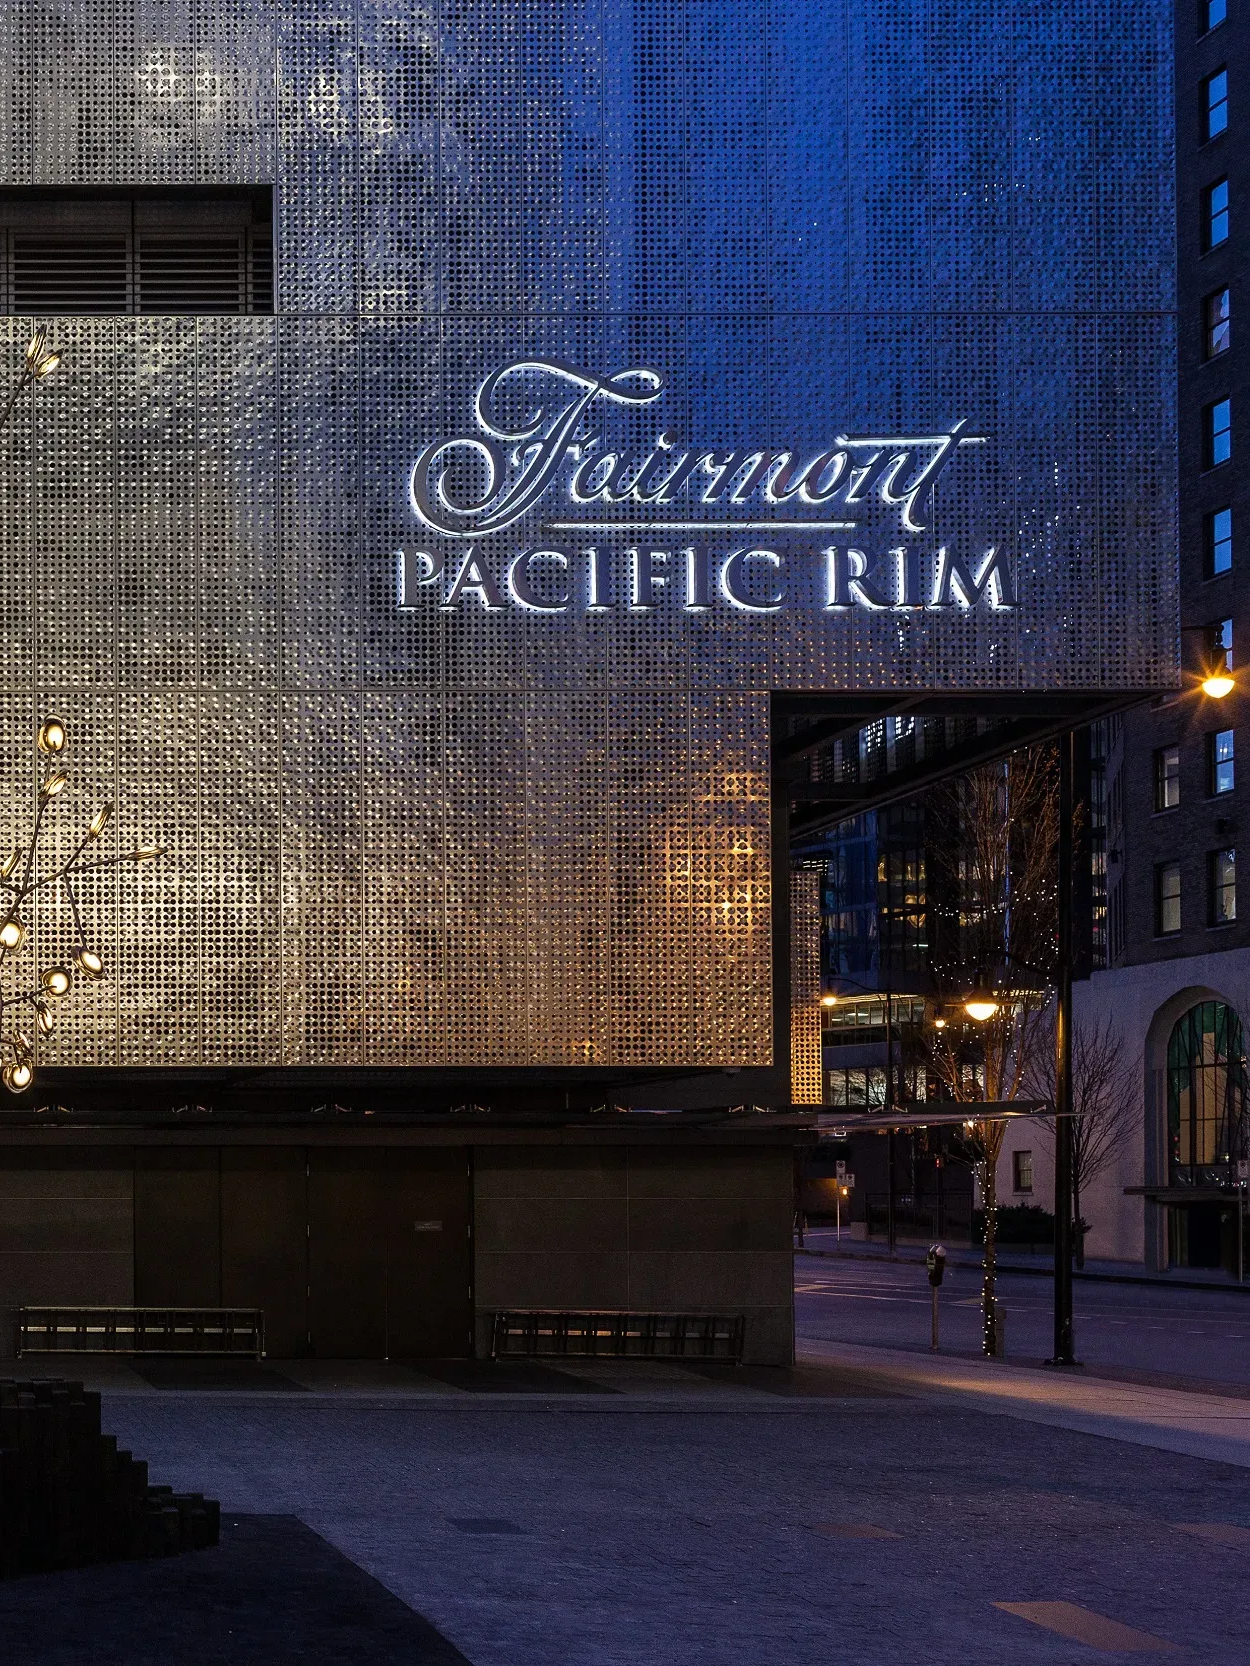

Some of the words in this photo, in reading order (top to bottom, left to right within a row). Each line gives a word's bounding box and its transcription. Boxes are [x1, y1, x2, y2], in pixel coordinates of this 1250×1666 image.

[411, 355, 996, 538] Fairmont
[395, 545, 790, 612] PACIFIC
[822, 544, 1023, 612] RIM
